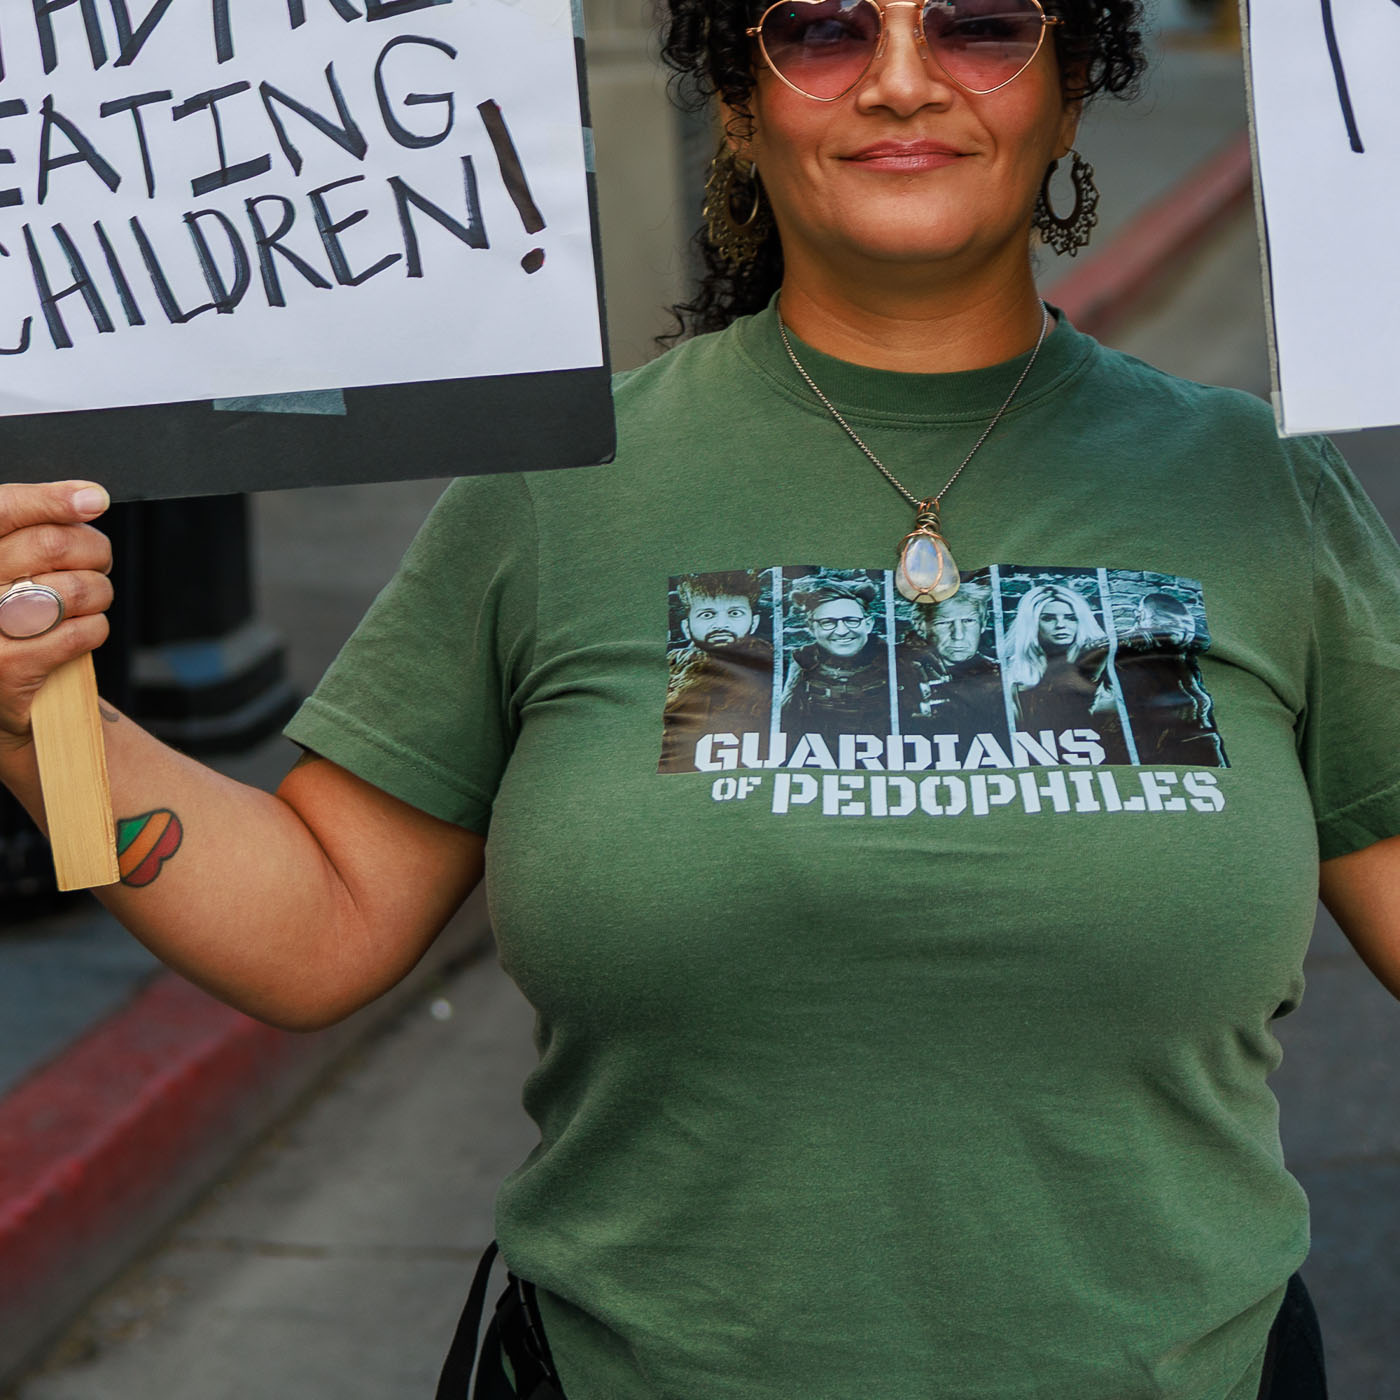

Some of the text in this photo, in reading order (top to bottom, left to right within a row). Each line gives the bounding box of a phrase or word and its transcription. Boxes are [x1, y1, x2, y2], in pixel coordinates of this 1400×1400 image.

[694, 727, 1106, 772] GUARDIANS
[711, 770, 1226, 817] OF PEDOPHILES
